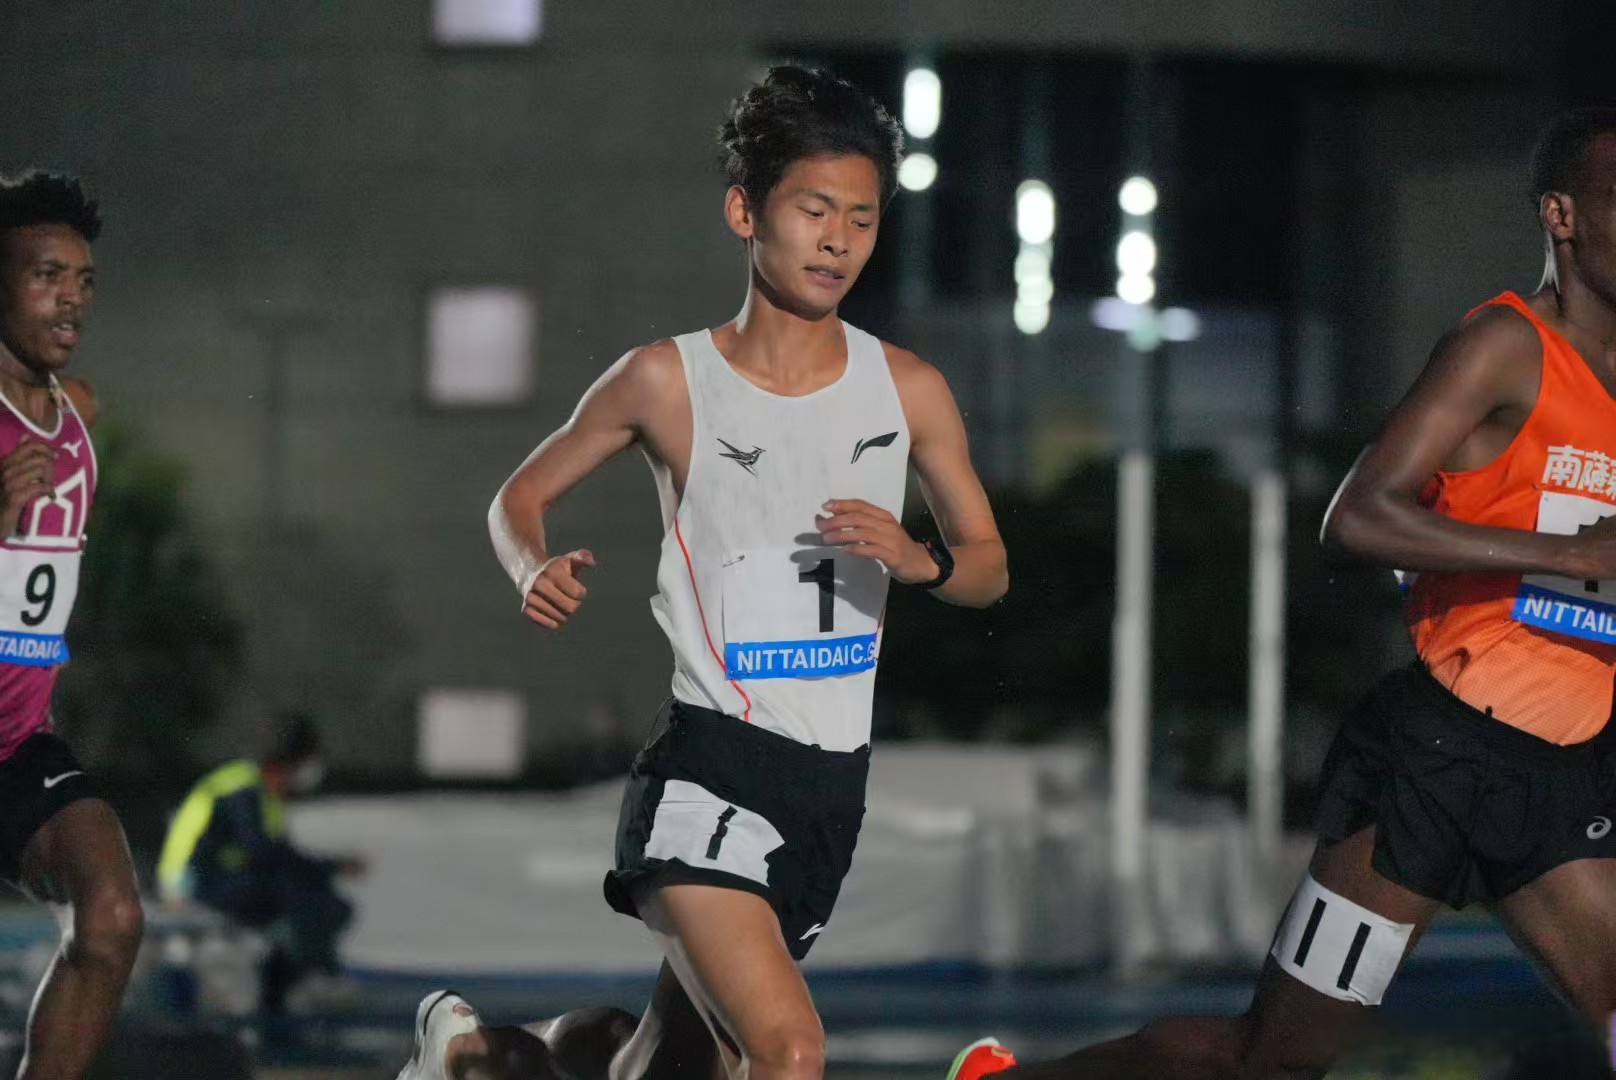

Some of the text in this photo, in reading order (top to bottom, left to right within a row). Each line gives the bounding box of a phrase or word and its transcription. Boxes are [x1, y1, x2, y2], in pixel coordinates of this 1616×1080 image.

[20, 564, 56, 627] 9
[799, 558, 834, 633] 1
[705, 805, 738, 861] 1
[1293, 897, 1371, 991] 11
